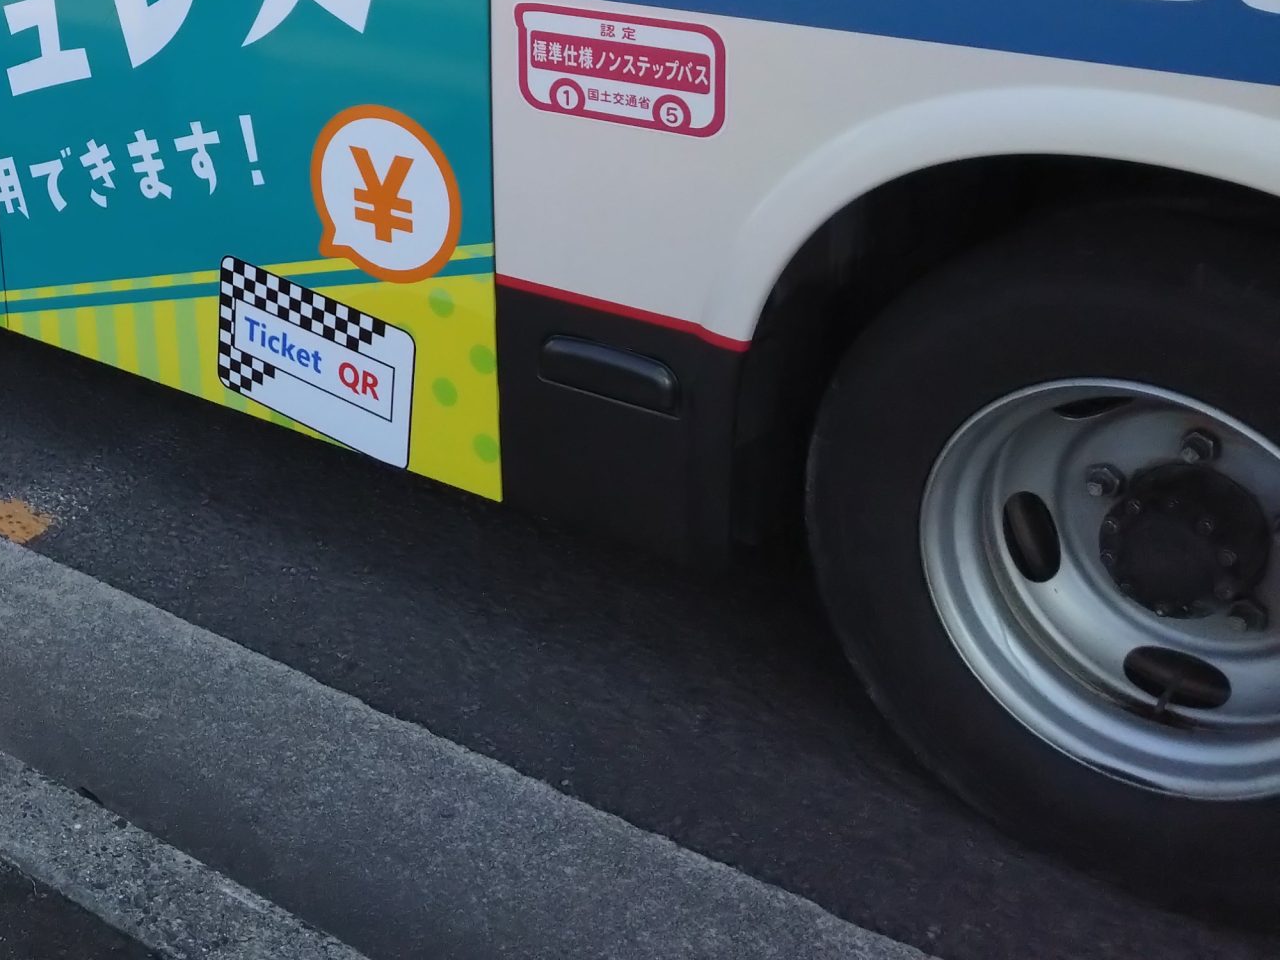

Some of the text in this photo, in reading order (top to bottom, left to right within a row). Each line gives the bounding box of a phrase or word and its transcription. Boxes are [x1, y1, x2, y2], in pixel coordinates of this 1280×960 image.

[600, 23, 636, 40] 認定
[533, 39, 709, 86] 標準仕様ノンステップバス
[588, 88, 651, 110] 国土交通省
[244, 316, 379, 401] Ticket QR
